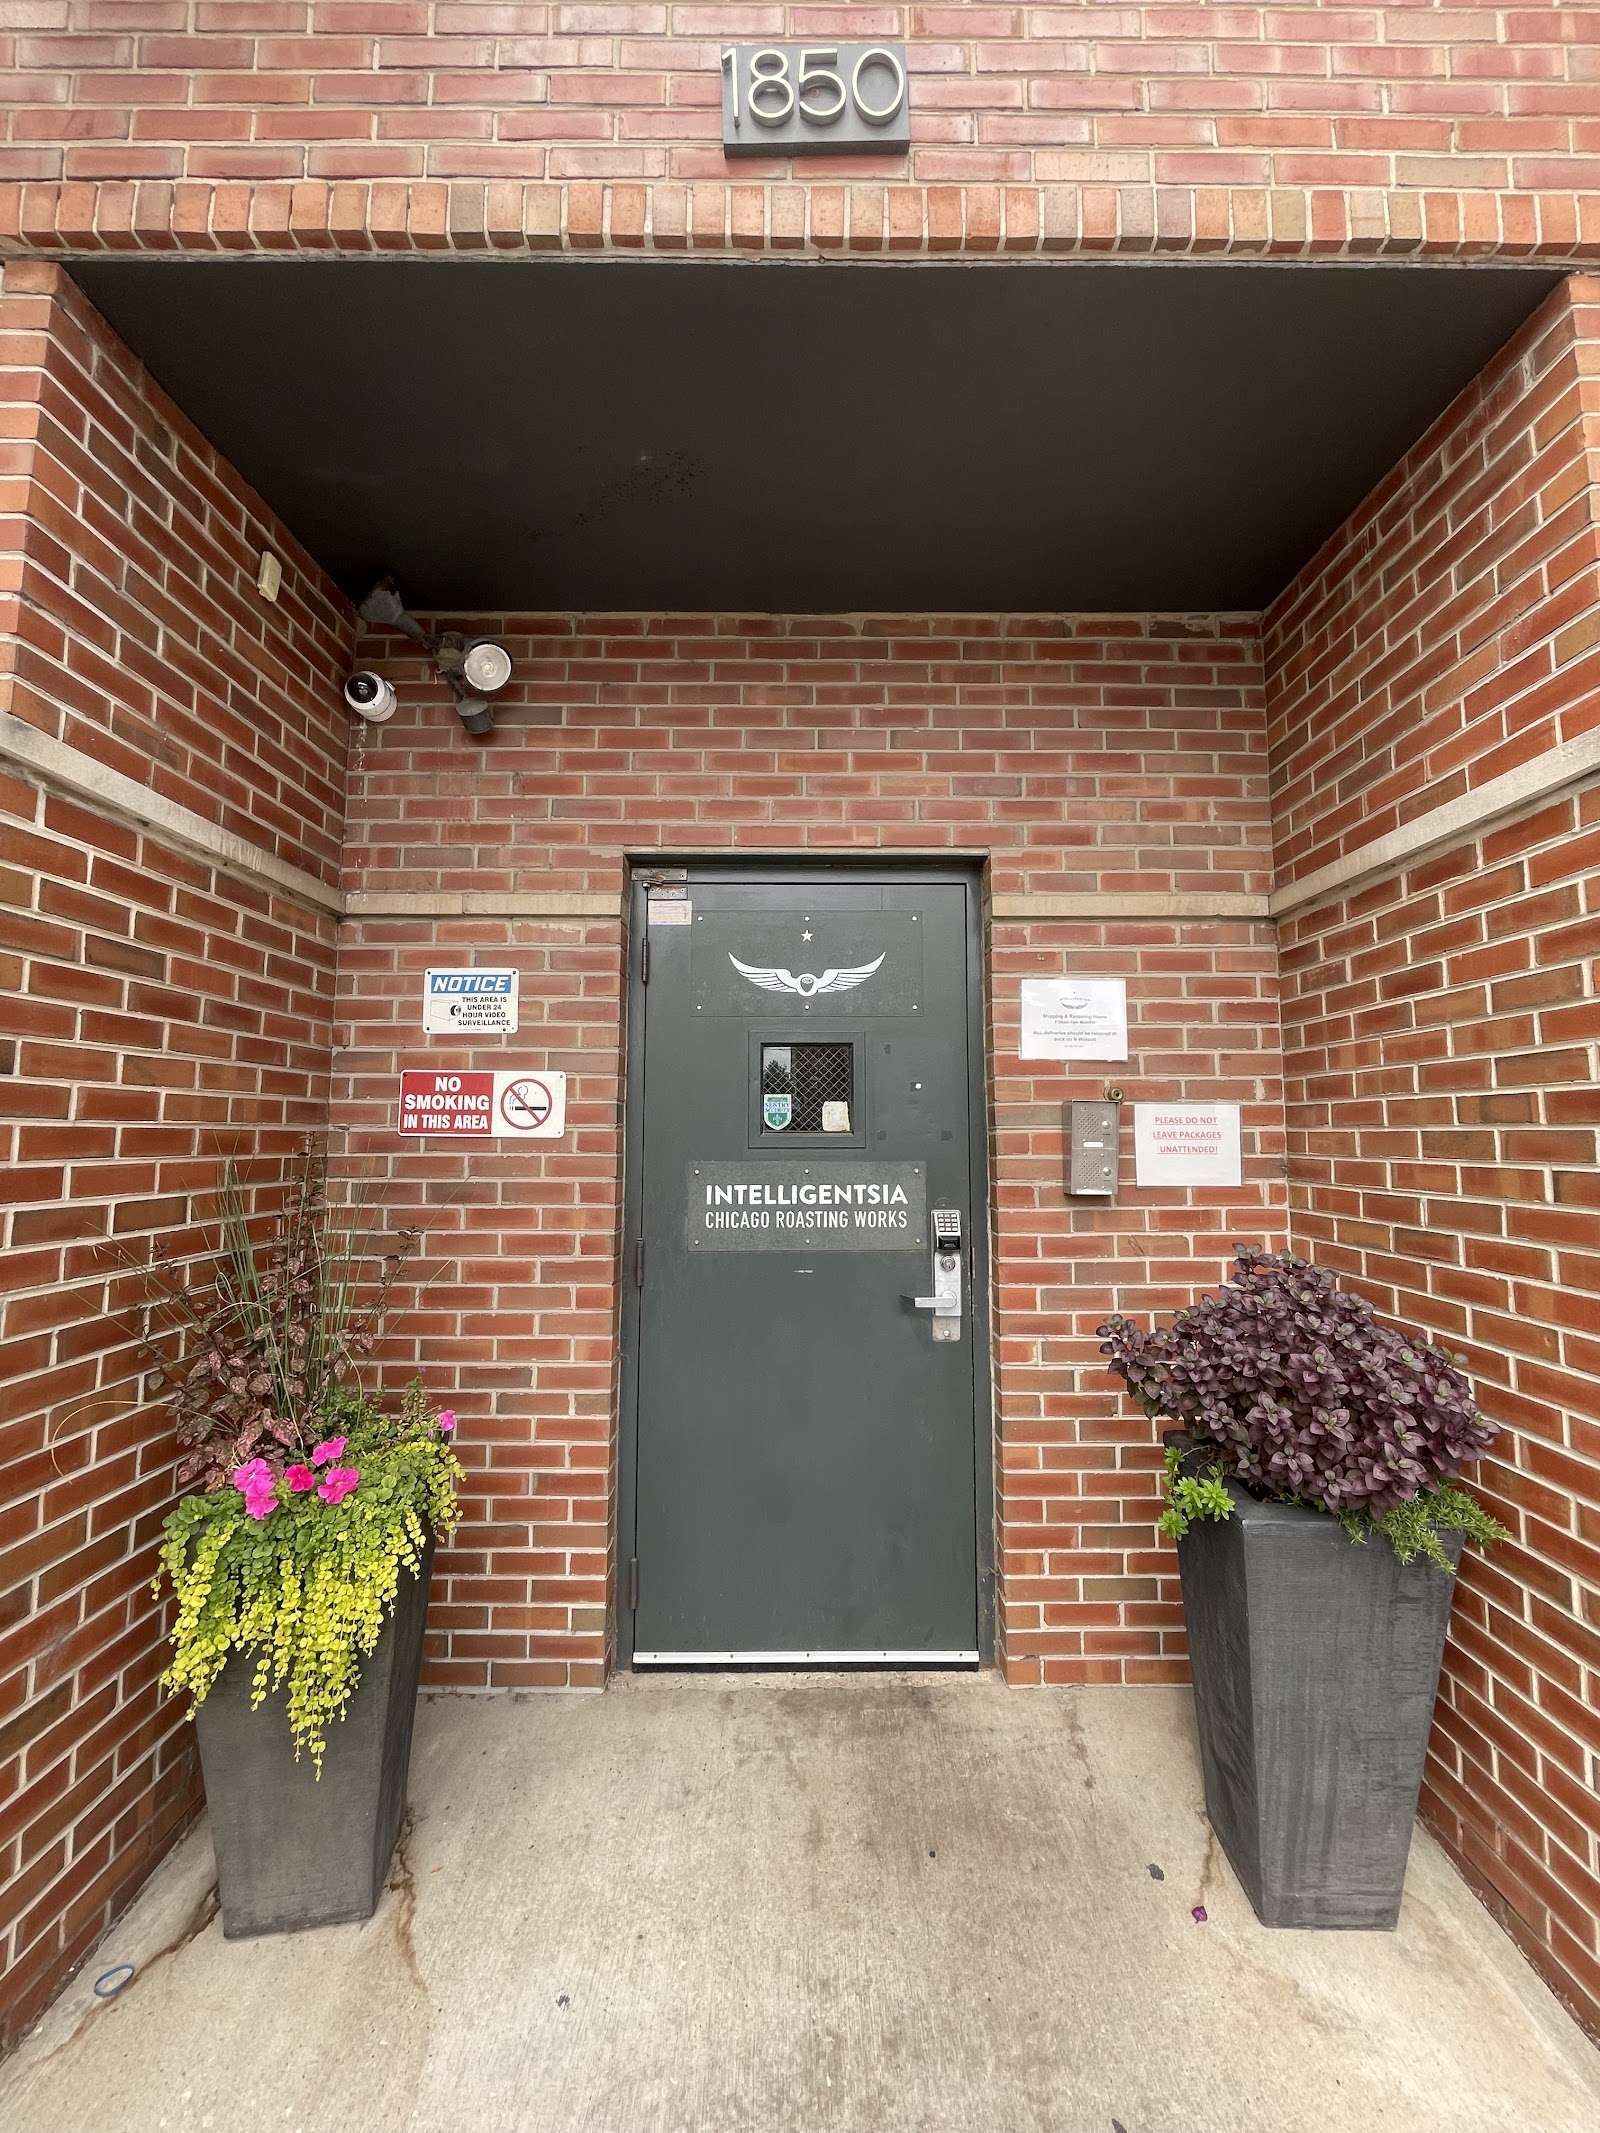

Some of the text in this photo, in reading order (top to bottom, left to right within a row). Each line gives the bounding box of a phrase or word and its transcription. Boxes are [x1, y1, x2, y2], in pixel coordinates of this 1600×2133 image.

[721, 47, 904, 118] 1850
[433, 976, 509, 992] NOTICE
[435, 1076, 462, 1092] NO
[404, 1094, 490, 1110] SMOKING
[403, 1114, 489, 1129] IN THIS AREA
[1155, 1116, 1218, 1124] PLEASE DO NOT
[1179, 1131, 1222, 1139] PACKAGES
[1159, 1145, 1218, 1153] UNATTENDED!
[706, 1184, 909, 1206] INTELLIGENTSIA
[705, 1210, 908, 1229] CHICAGO ROASTING WORKS
